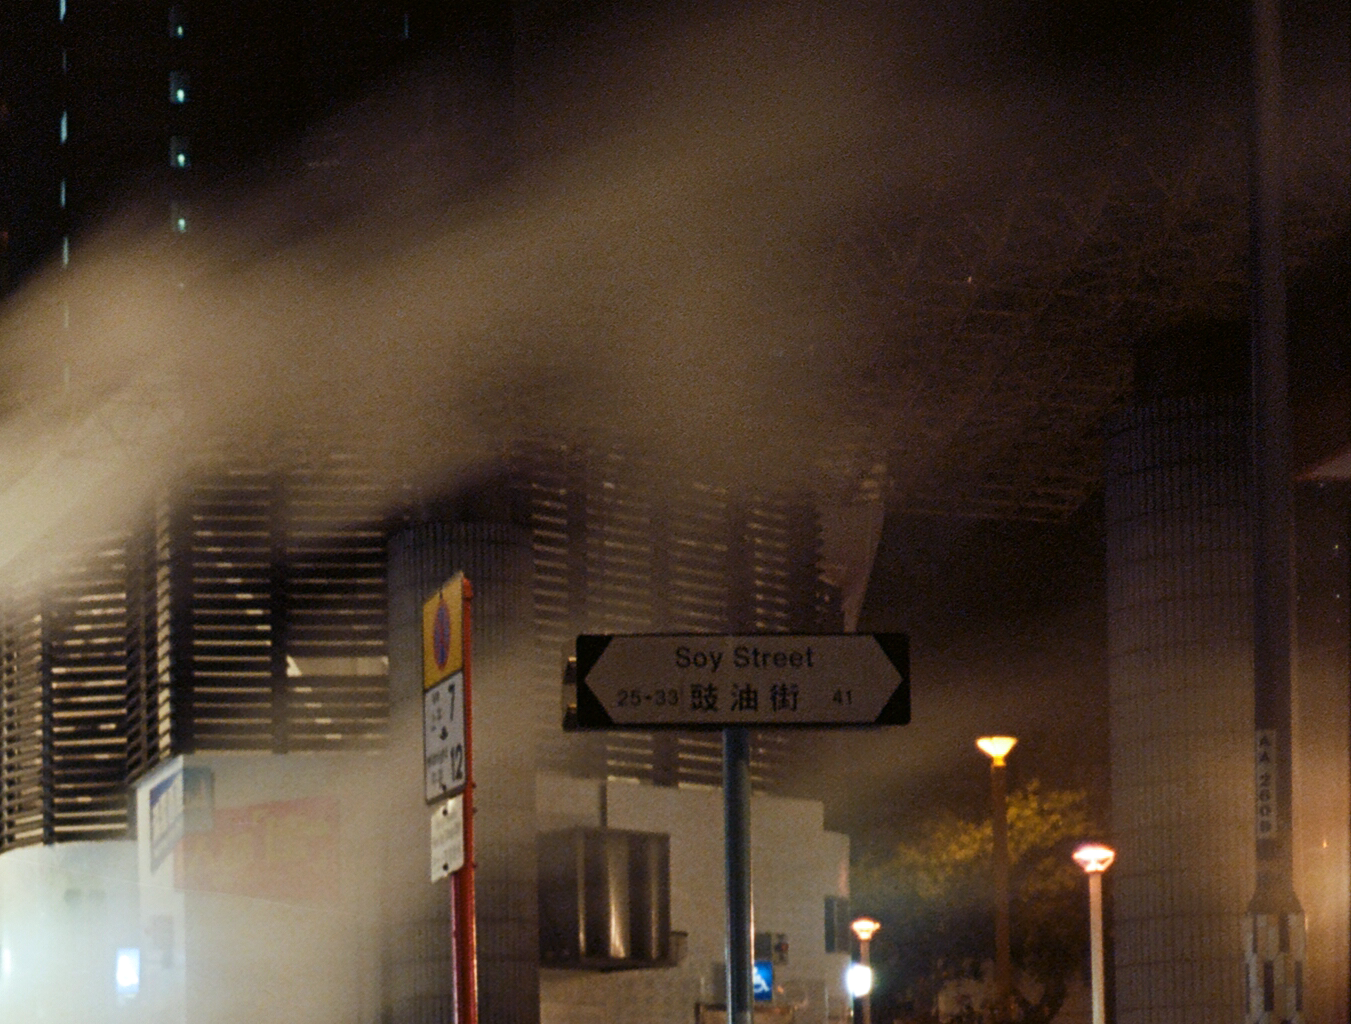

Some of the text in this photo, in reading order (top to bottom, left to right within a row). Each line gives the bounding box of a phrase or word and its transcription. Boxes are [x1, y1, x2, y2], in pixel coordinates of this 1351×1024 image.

[675, 646, 814, 673] Soy Street
[617, 683, 852, 712] 25-33 豉油街 41
[450, 743, 463, 782] 12
